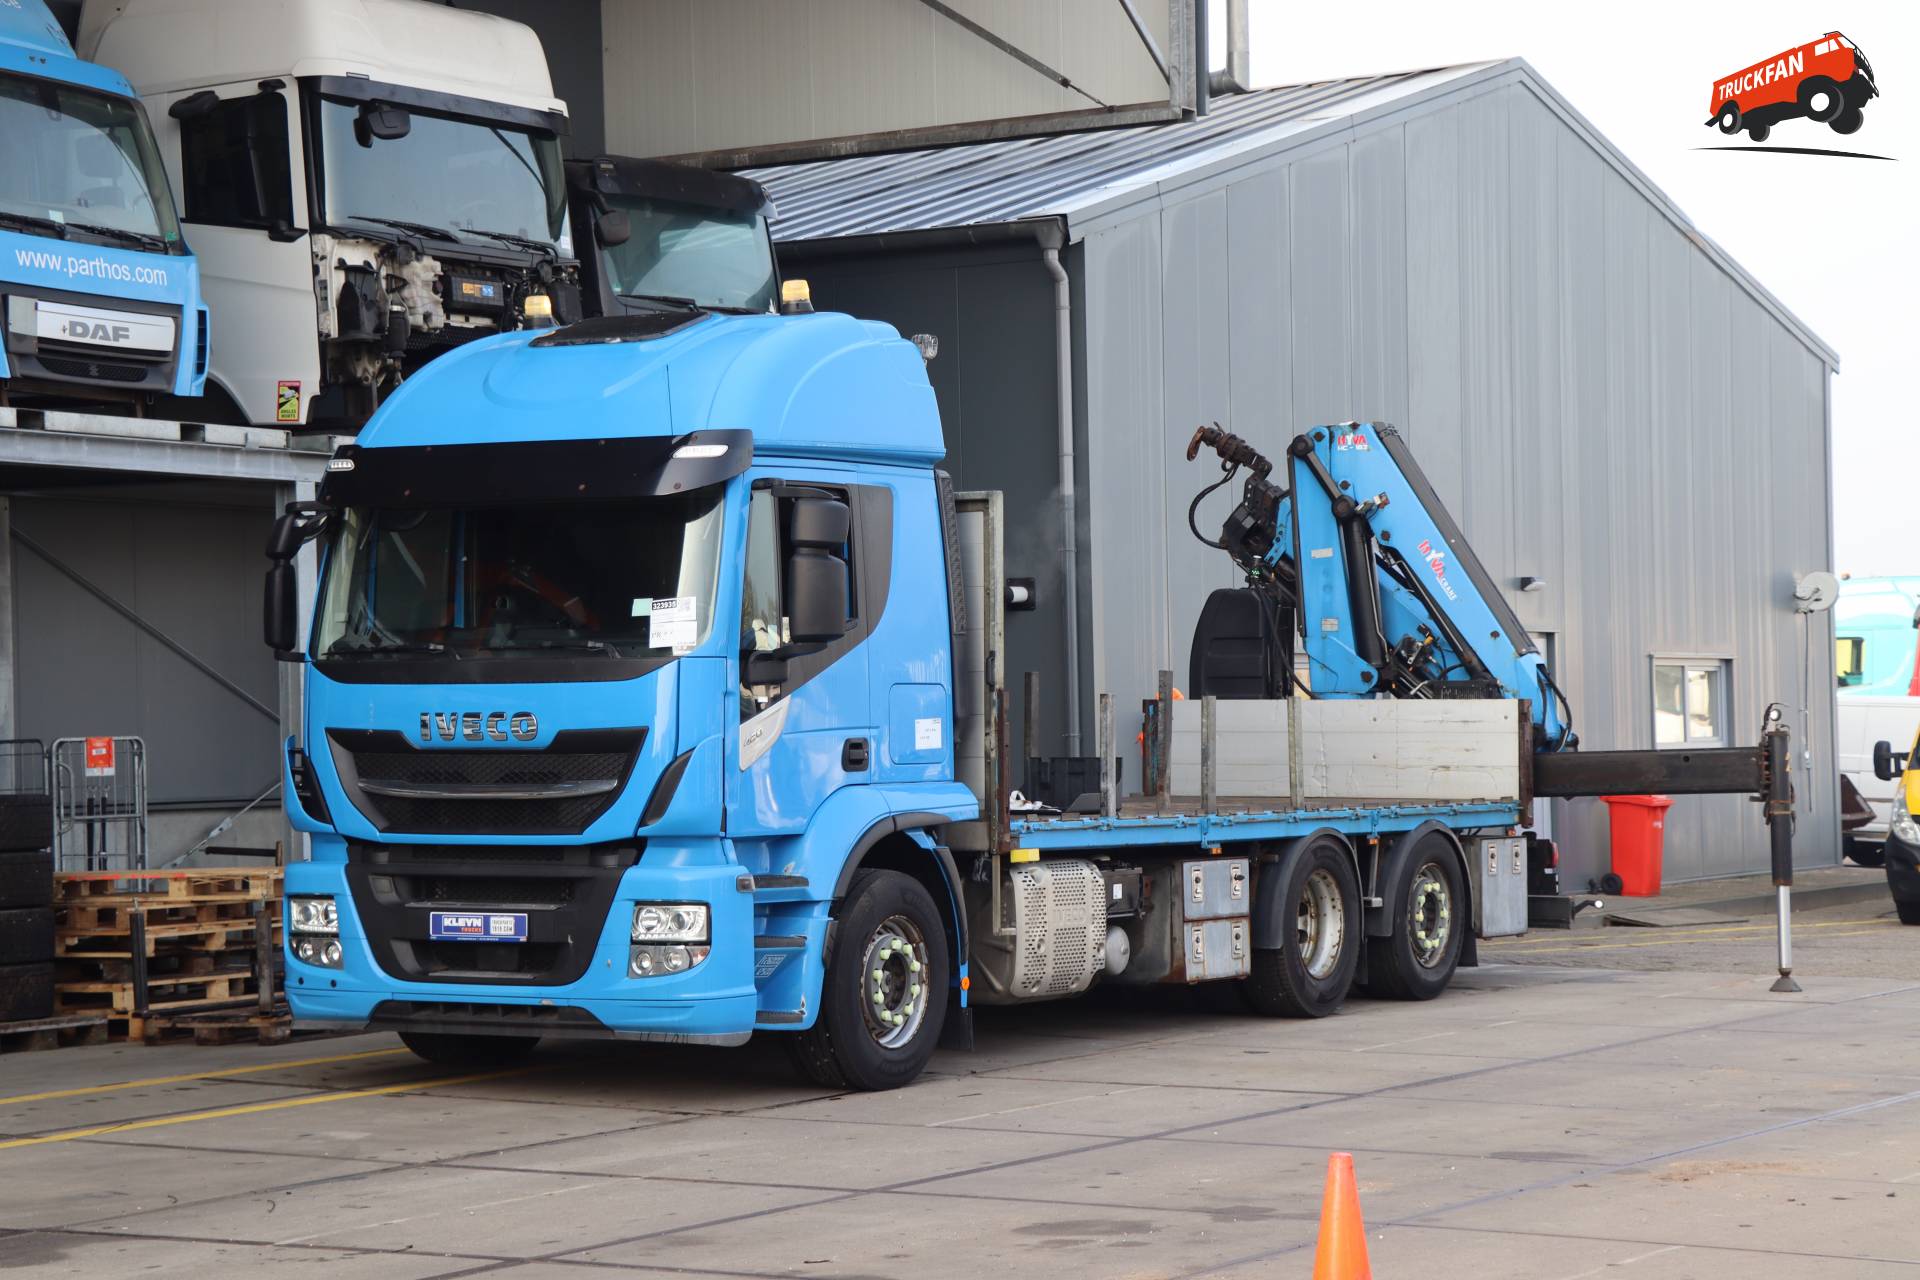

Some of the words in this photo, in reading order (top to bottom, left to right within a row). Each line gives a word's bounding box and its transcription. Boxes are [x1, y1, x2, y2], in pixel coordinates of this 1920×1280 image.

[16, 249, 168, 286] www.parthos.com
[68, 320, 130, 342] DAF
[1337, 432, 1368, 446] HYVA
[1417, 539, 1445, 580] HYVA
[420, 711, 539, 742] IVECO
[443, 917, 482, 927] KLEYN
